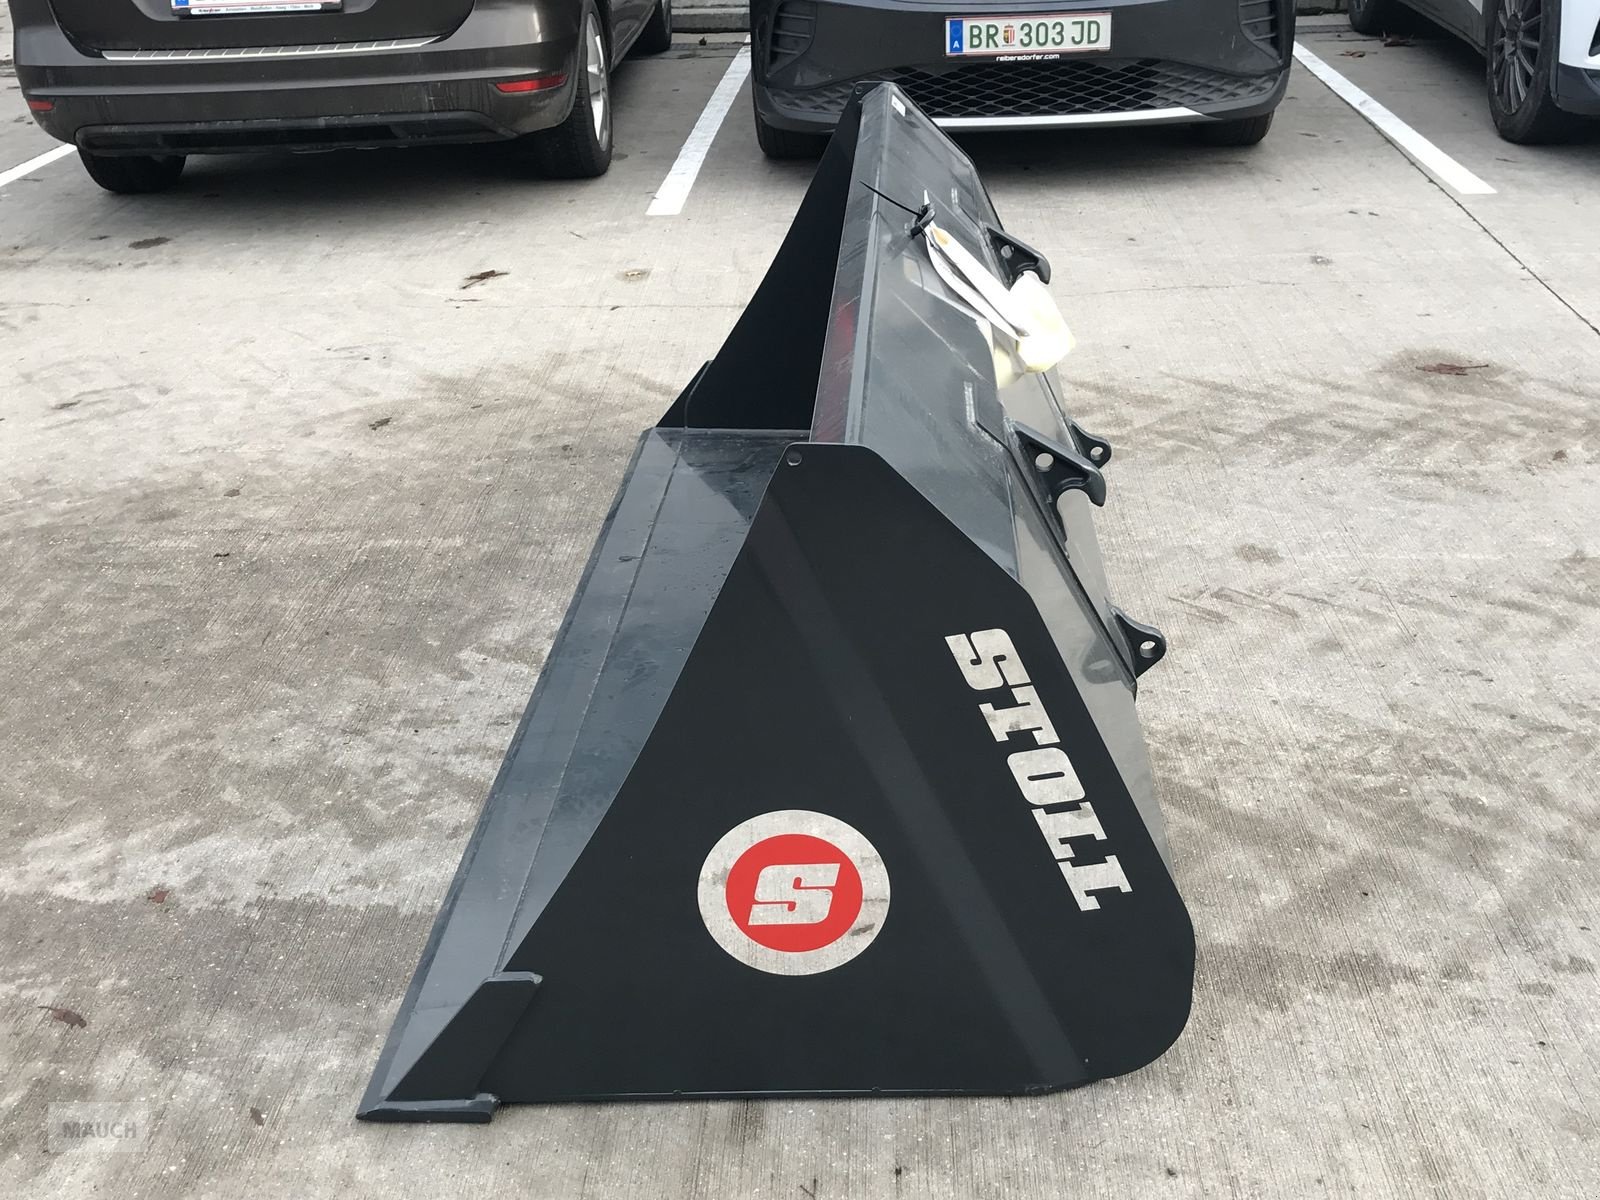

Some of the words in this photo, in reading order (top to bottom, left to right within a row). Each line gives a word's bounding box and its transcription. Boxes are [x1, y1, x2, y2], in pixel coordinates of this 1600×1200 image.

[952, 40, 960, 49] A
[969, 24, 999, 49] BR
[1020, 22, 1065, 47] 303
[1071, 20, 1101, 45] JD
[996, 54, 1060, 62] reibersdorfer.com
[944, 628, 1133, 912] STOLL
[747, 862, 841, 926] S
